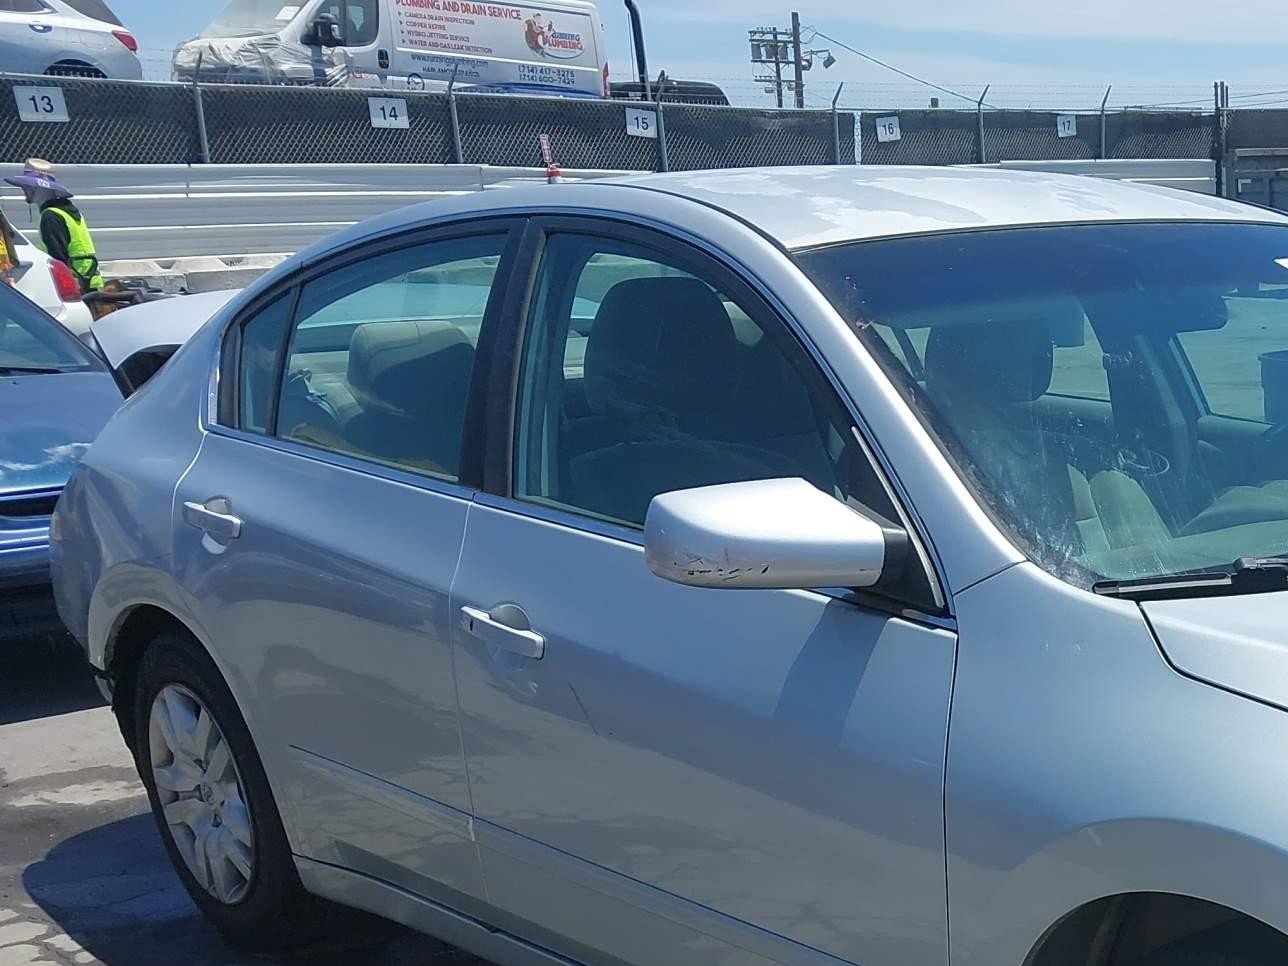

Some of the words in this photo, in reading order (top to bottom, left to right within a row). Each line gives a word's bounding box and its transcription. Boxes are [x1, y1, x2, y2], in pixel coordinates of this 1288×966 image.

[442, 1, 460, 13] AND
[461, 4, 487, 16] DRAIN
[487, 7, 521, 20] SERVICE
[29, 95, 54, 113] 13
[379, 105, 399, 121] 14
[634, 116, 649, 131] 15
[882, 122, 895, 136] 16
[1062, 120, 1071, 131] 17
